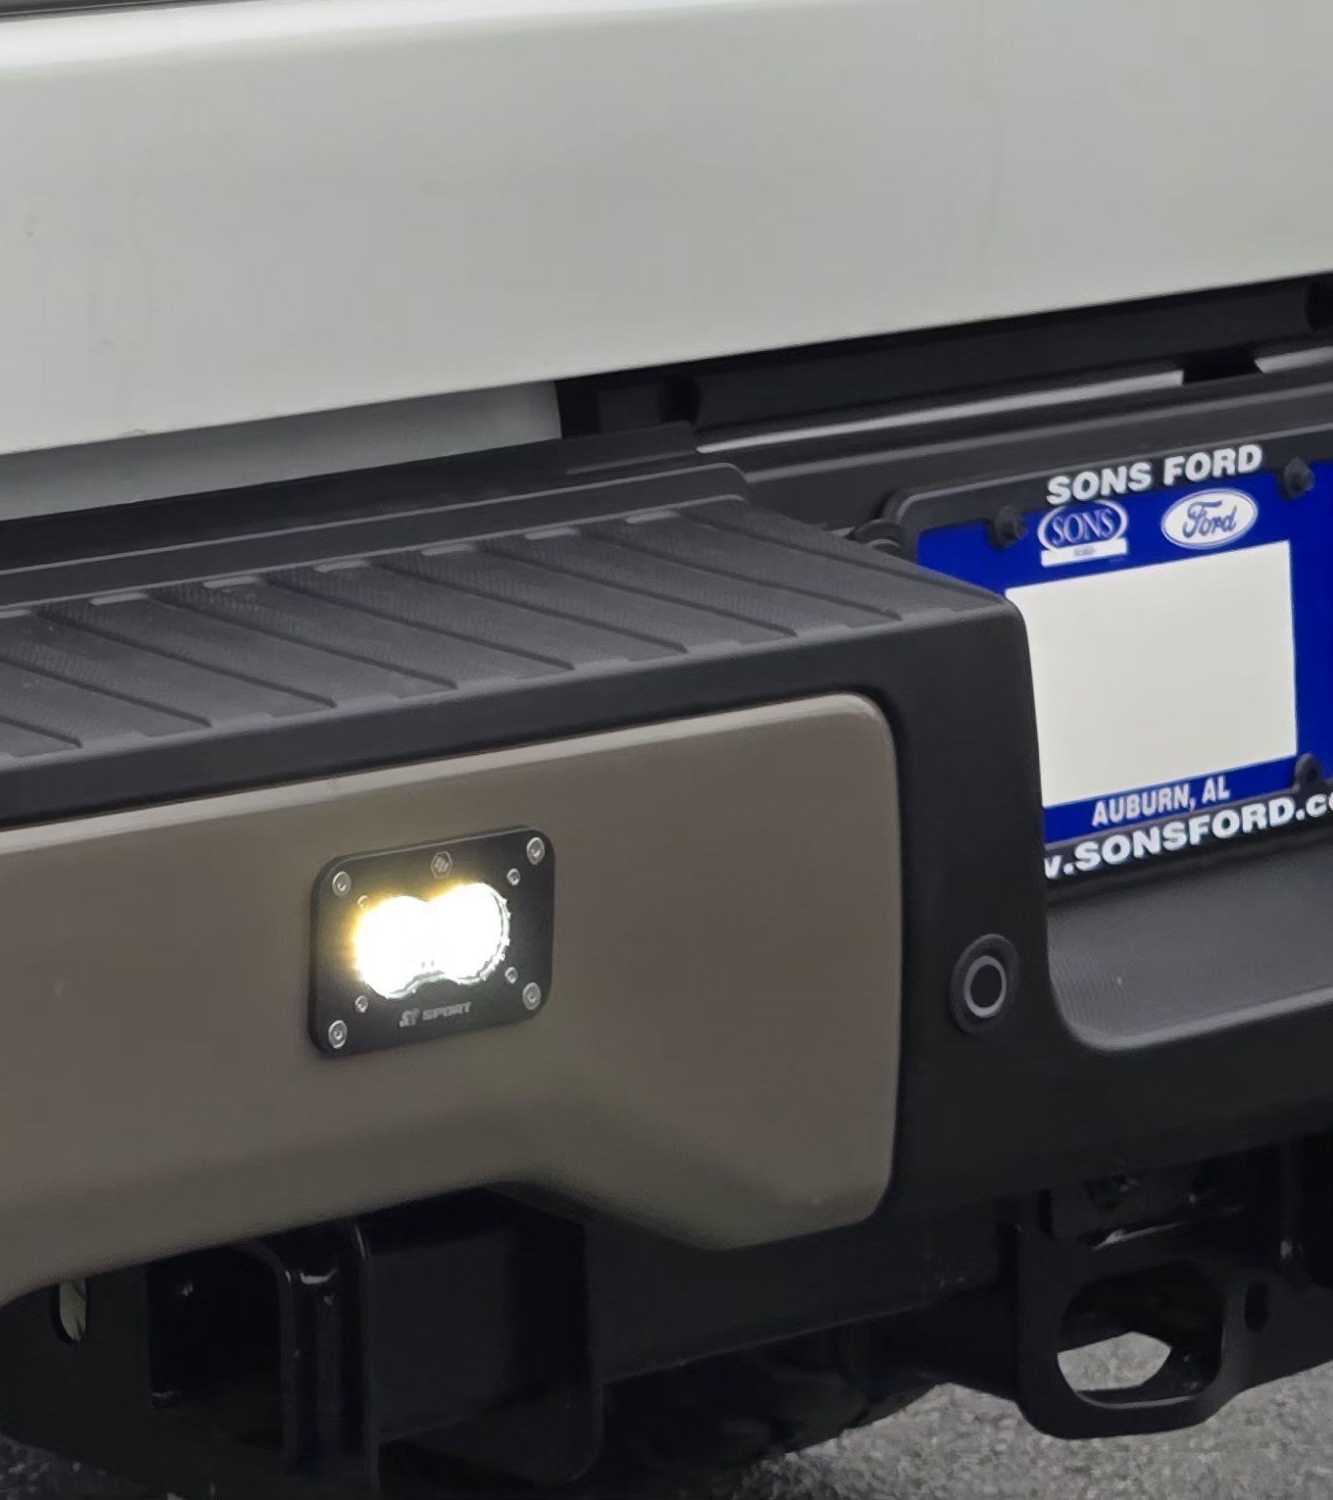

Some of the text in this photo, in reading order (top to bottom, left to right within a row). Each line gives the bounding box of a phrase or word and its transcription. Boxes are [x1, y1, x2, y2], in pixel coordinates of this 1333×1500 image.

[1046, 443, 1263, 506] SONS FORD
[1051, 499, 1238, 546] SONS Ford
[1091, 775, 1230, 828] AUBURN, AL
